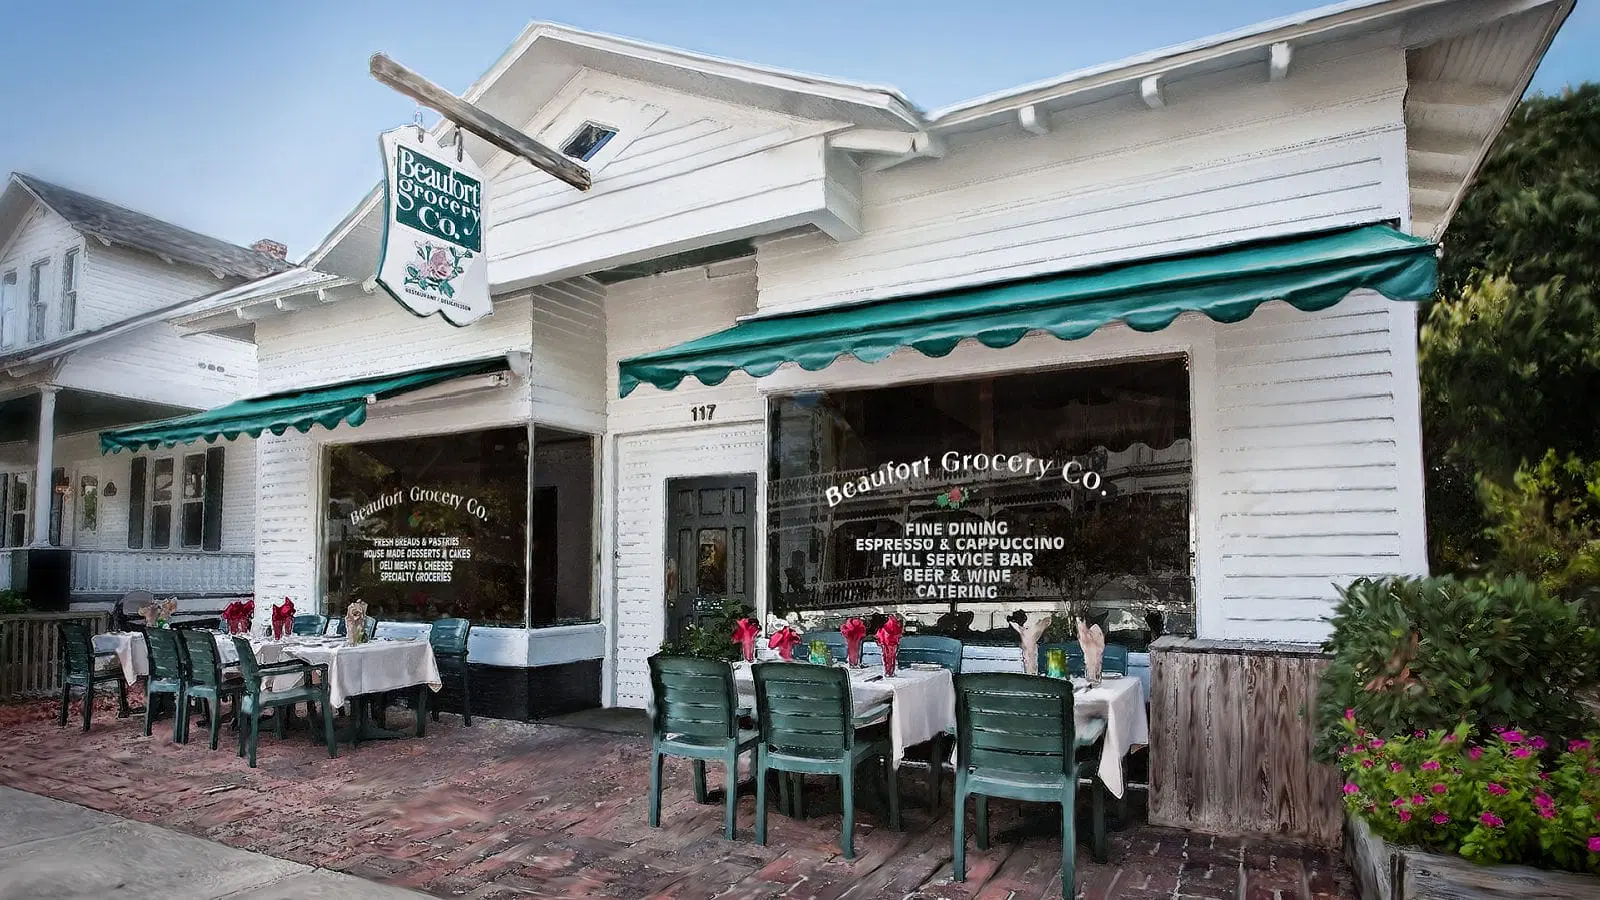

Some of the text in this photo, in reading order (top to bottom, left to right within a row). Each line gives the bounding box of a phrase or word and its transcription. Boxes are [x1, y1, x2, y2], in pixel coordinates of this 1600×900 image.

[400, 149, 480, 207] Beaufort
[398, 178, 480, 236] grocery
[419, 207, 460, 240] Co.
[691, 404, 717, 421] 117
[825, 451, 1107, 508] Beaufort Grocery Co.
[350, 485, 488, 526] Beaufort Grocery Co.
[906, 521, 1008, 536] FINE DINING
[374, 537, 459, 546] FRESH BREADS & PASTRIES
[855, 537, 1065, 551] ESPRESSO & CAPPUCCINO
[363, 549, 385, 558] HOUSE
[386, 549, 406, 558] MADE
[406, 549, 440, 558] DESSERTS
[449, 549, 471, 558] CAKES
[882, 552, 1034, 567] FULL SERVICE BAR
[379, 560, 393, 570] DELI
[394, 560, 417, 570] MEATS
[424, 561, 453, 571] CHEESES
[380, 572, 452, 582] SPECIALTY GROCERIES
[903, 569, 1011, 583] BEER & WINE
[916, 584, 998, 599] CATERING
